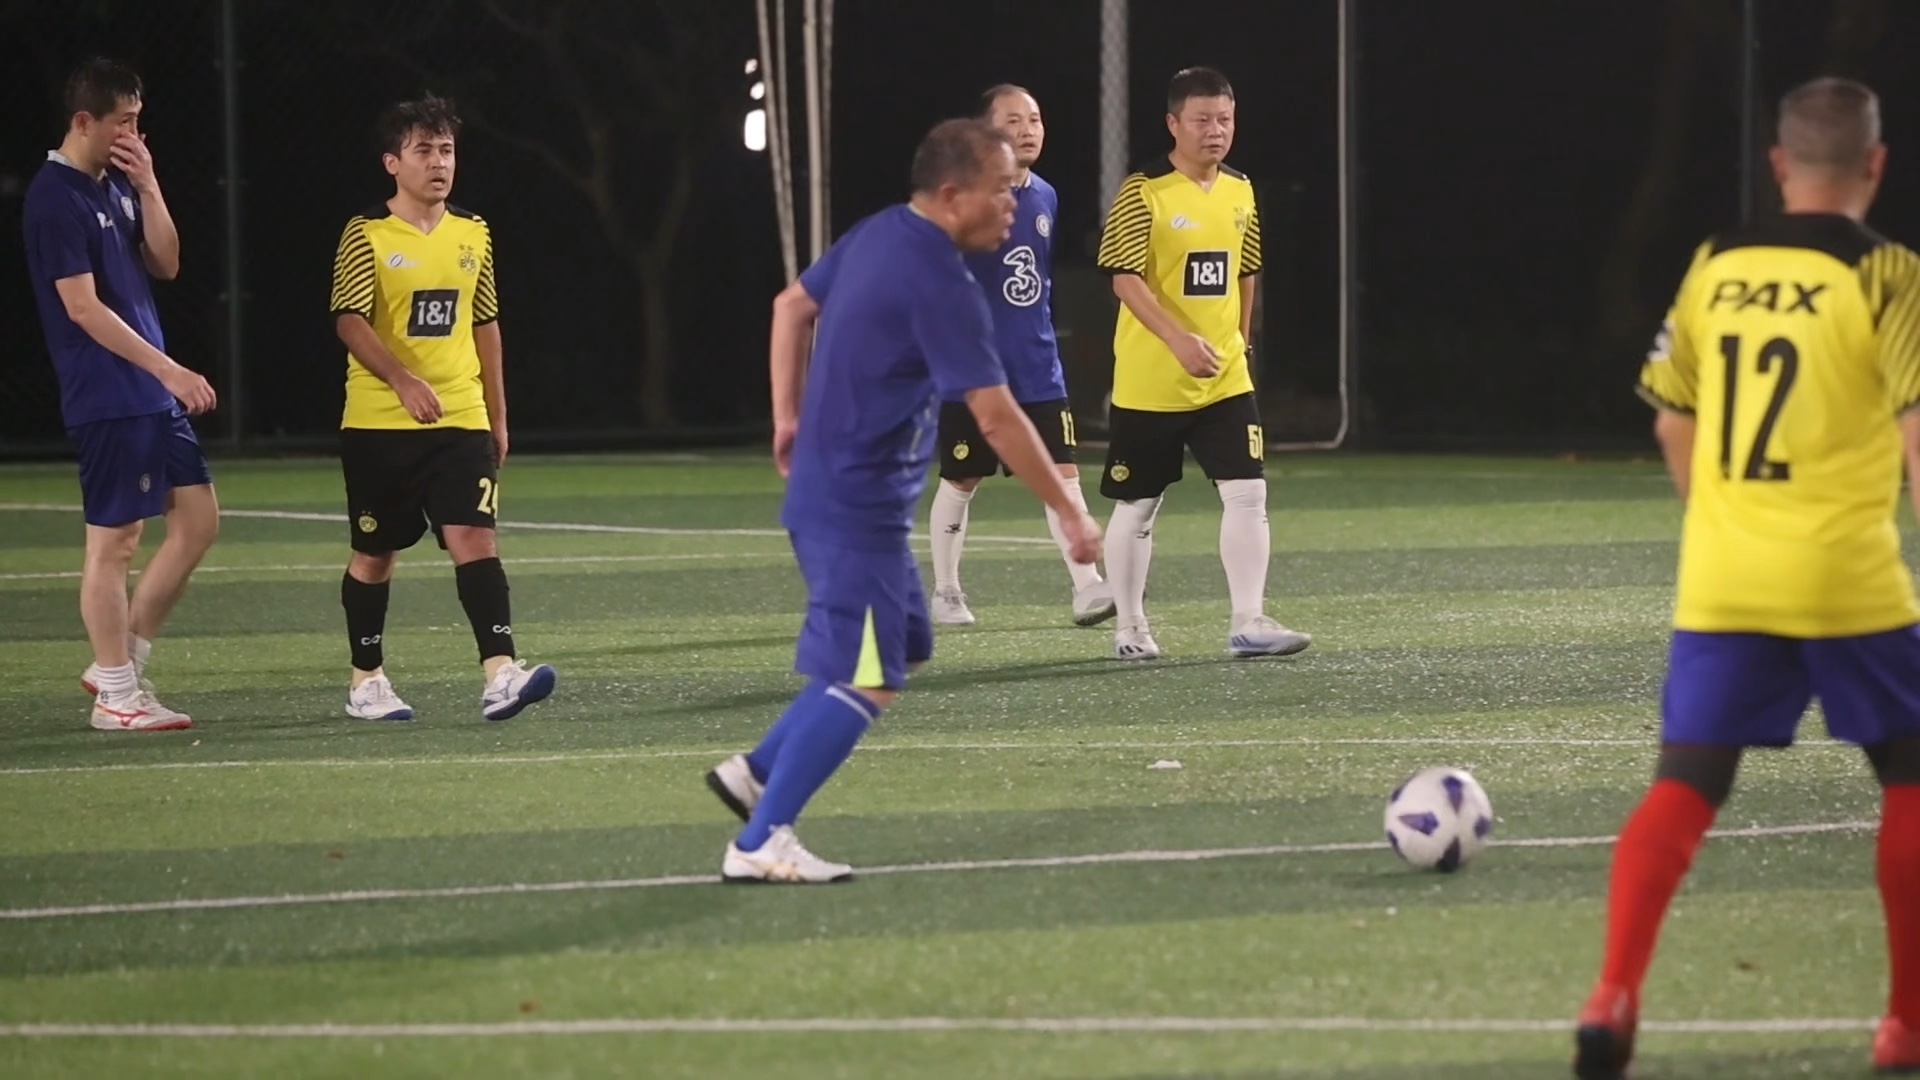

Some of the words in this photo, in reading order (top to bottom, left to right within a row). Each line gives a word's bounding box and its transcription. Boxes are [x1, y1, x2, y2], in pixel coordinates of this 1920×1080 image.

[1003, 245, 1042, 306] 3
[1190, 261, 1224, 286] 1&1
[417, 300, 453, 326] 1&1
[1708, 279, 1826, 315] PAX
[1719, 334, 1798, 481] 12
